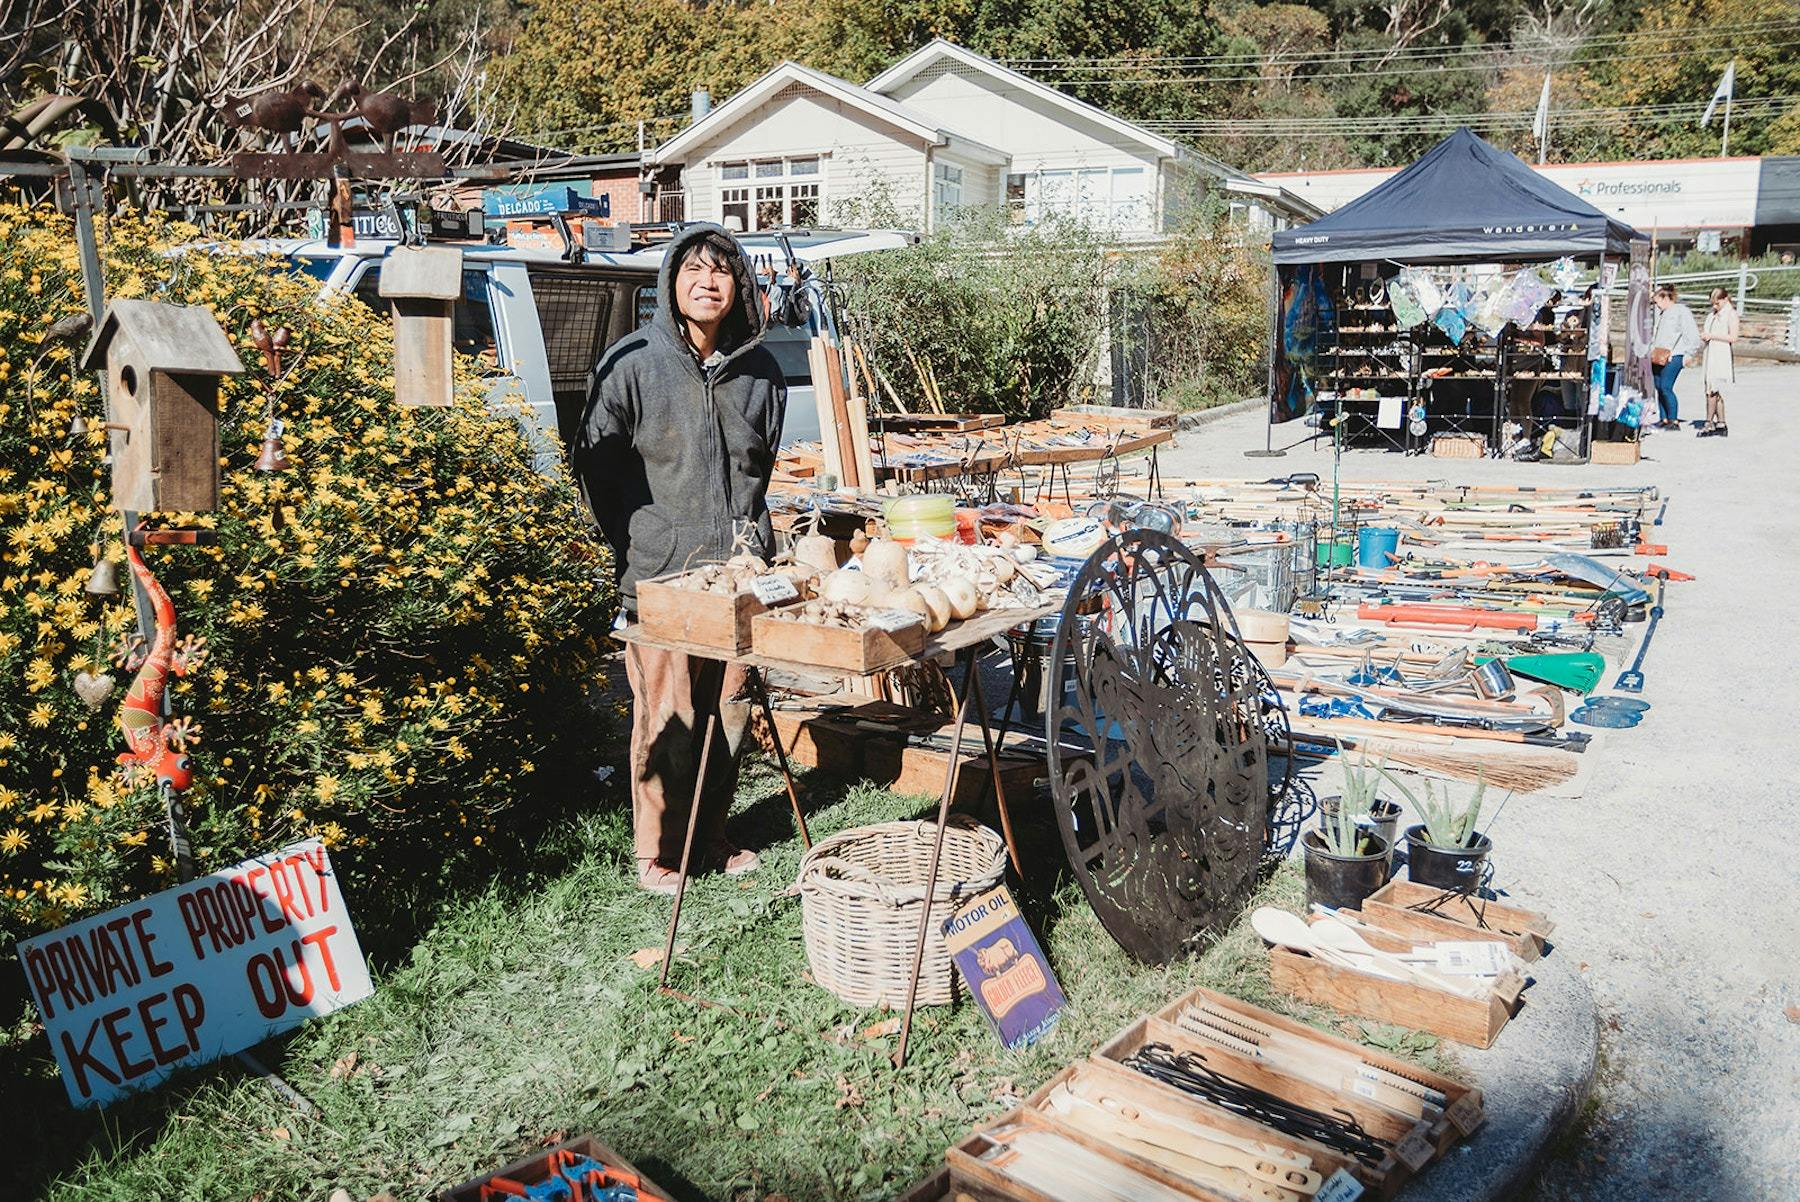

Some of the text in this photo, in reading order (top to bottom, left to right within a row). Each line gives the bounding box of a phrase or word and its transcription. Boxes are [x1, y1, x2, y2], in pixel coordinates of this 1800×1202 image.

[1597, 180, 1682, 195] Professionals
[1295, 237, 1313, 245] HEAVY
[25, 846, 330, 1019] PRIVATE PROPERTY
[948, 893, 1010, 938] MOTOR OIL
[60, 925, 341, 1098] KEEP OUT
